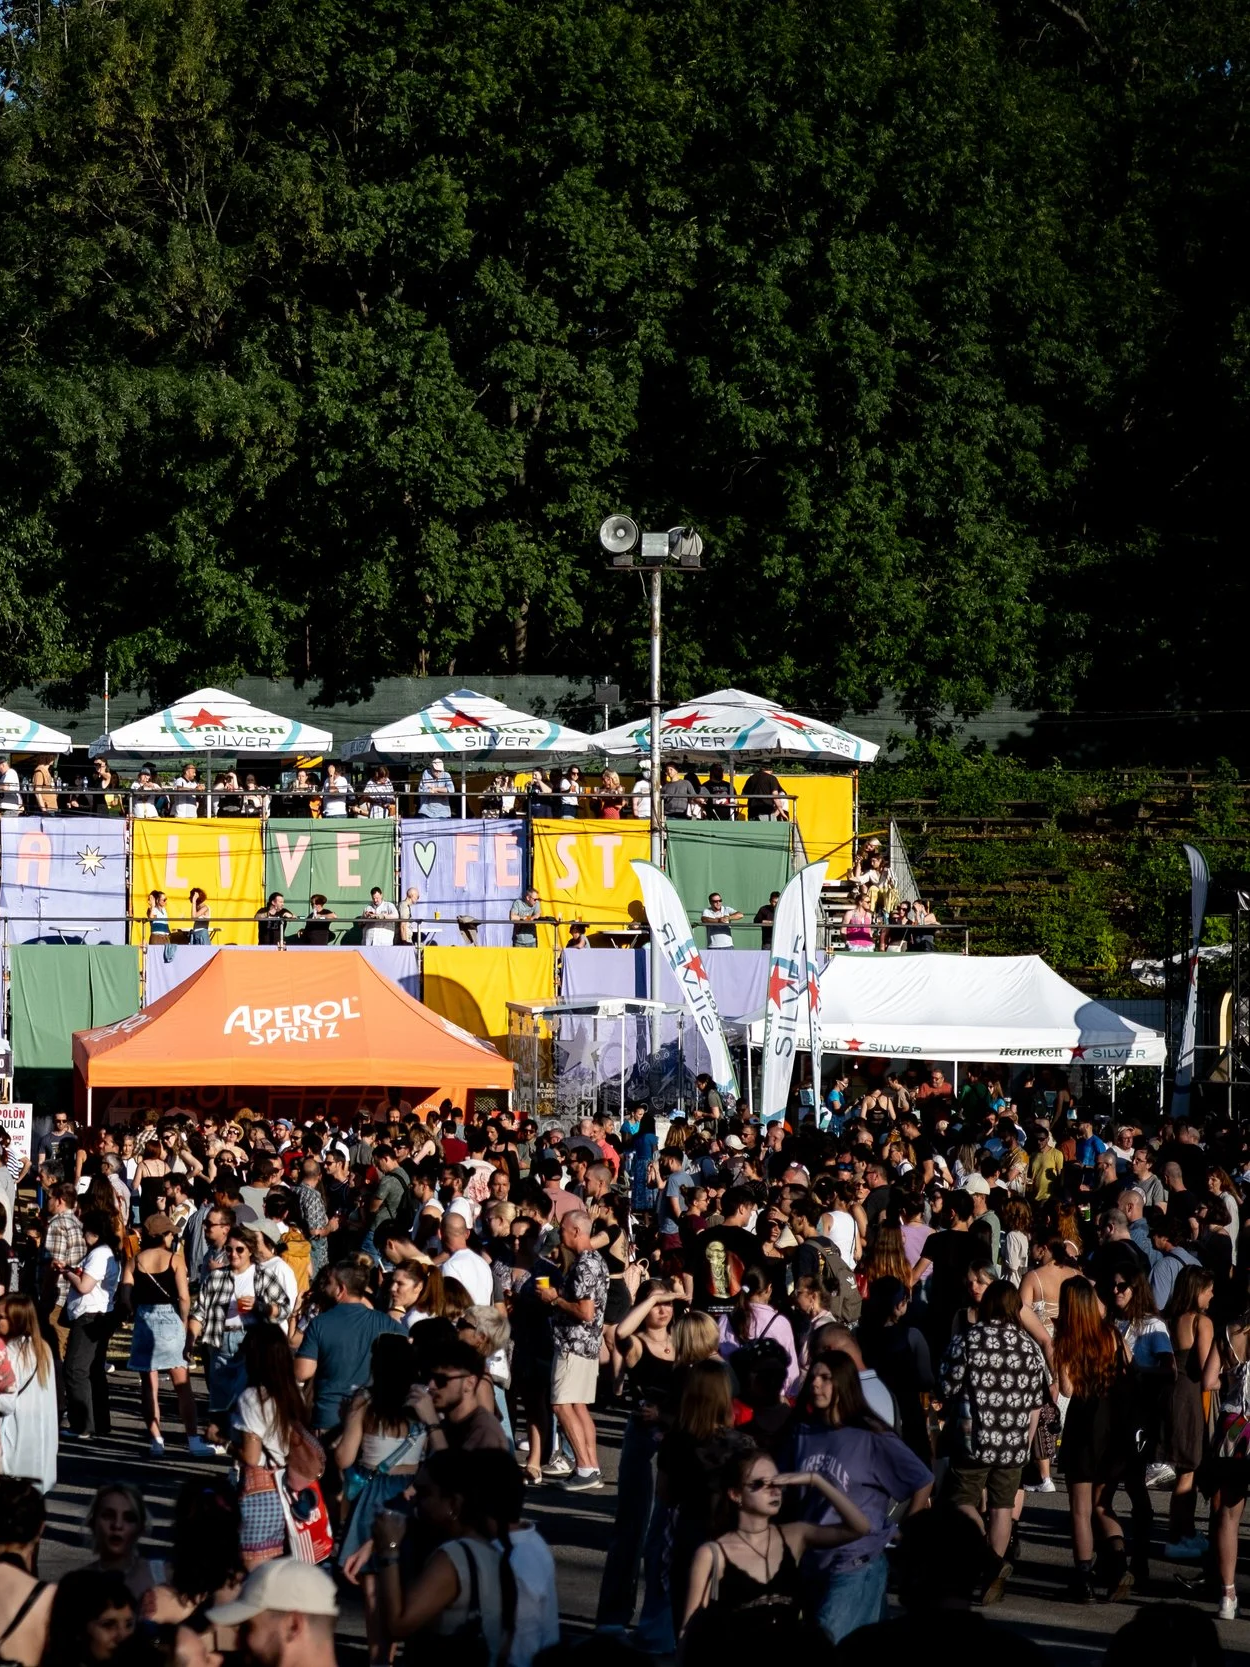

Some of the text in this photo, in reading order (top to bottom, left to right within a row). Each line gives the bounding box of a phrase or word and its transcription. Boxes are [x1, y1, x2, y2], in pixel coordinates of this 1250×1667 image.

[160, 725, 285, 734] Heineken
[205, 735, 271, 748] SILVER
[465, 736, 531, 747] SILVER
[663, 736, 726, 748] SILVER
[165, 832, 362, 889] LIVE
[454, 833, 623, 889] FEST
[223, 997, 361, 1035] APEROL
[868, 1043, 923, 1054] SILVER
[999, 1048, 1146, 1059] Heineken SILVER
